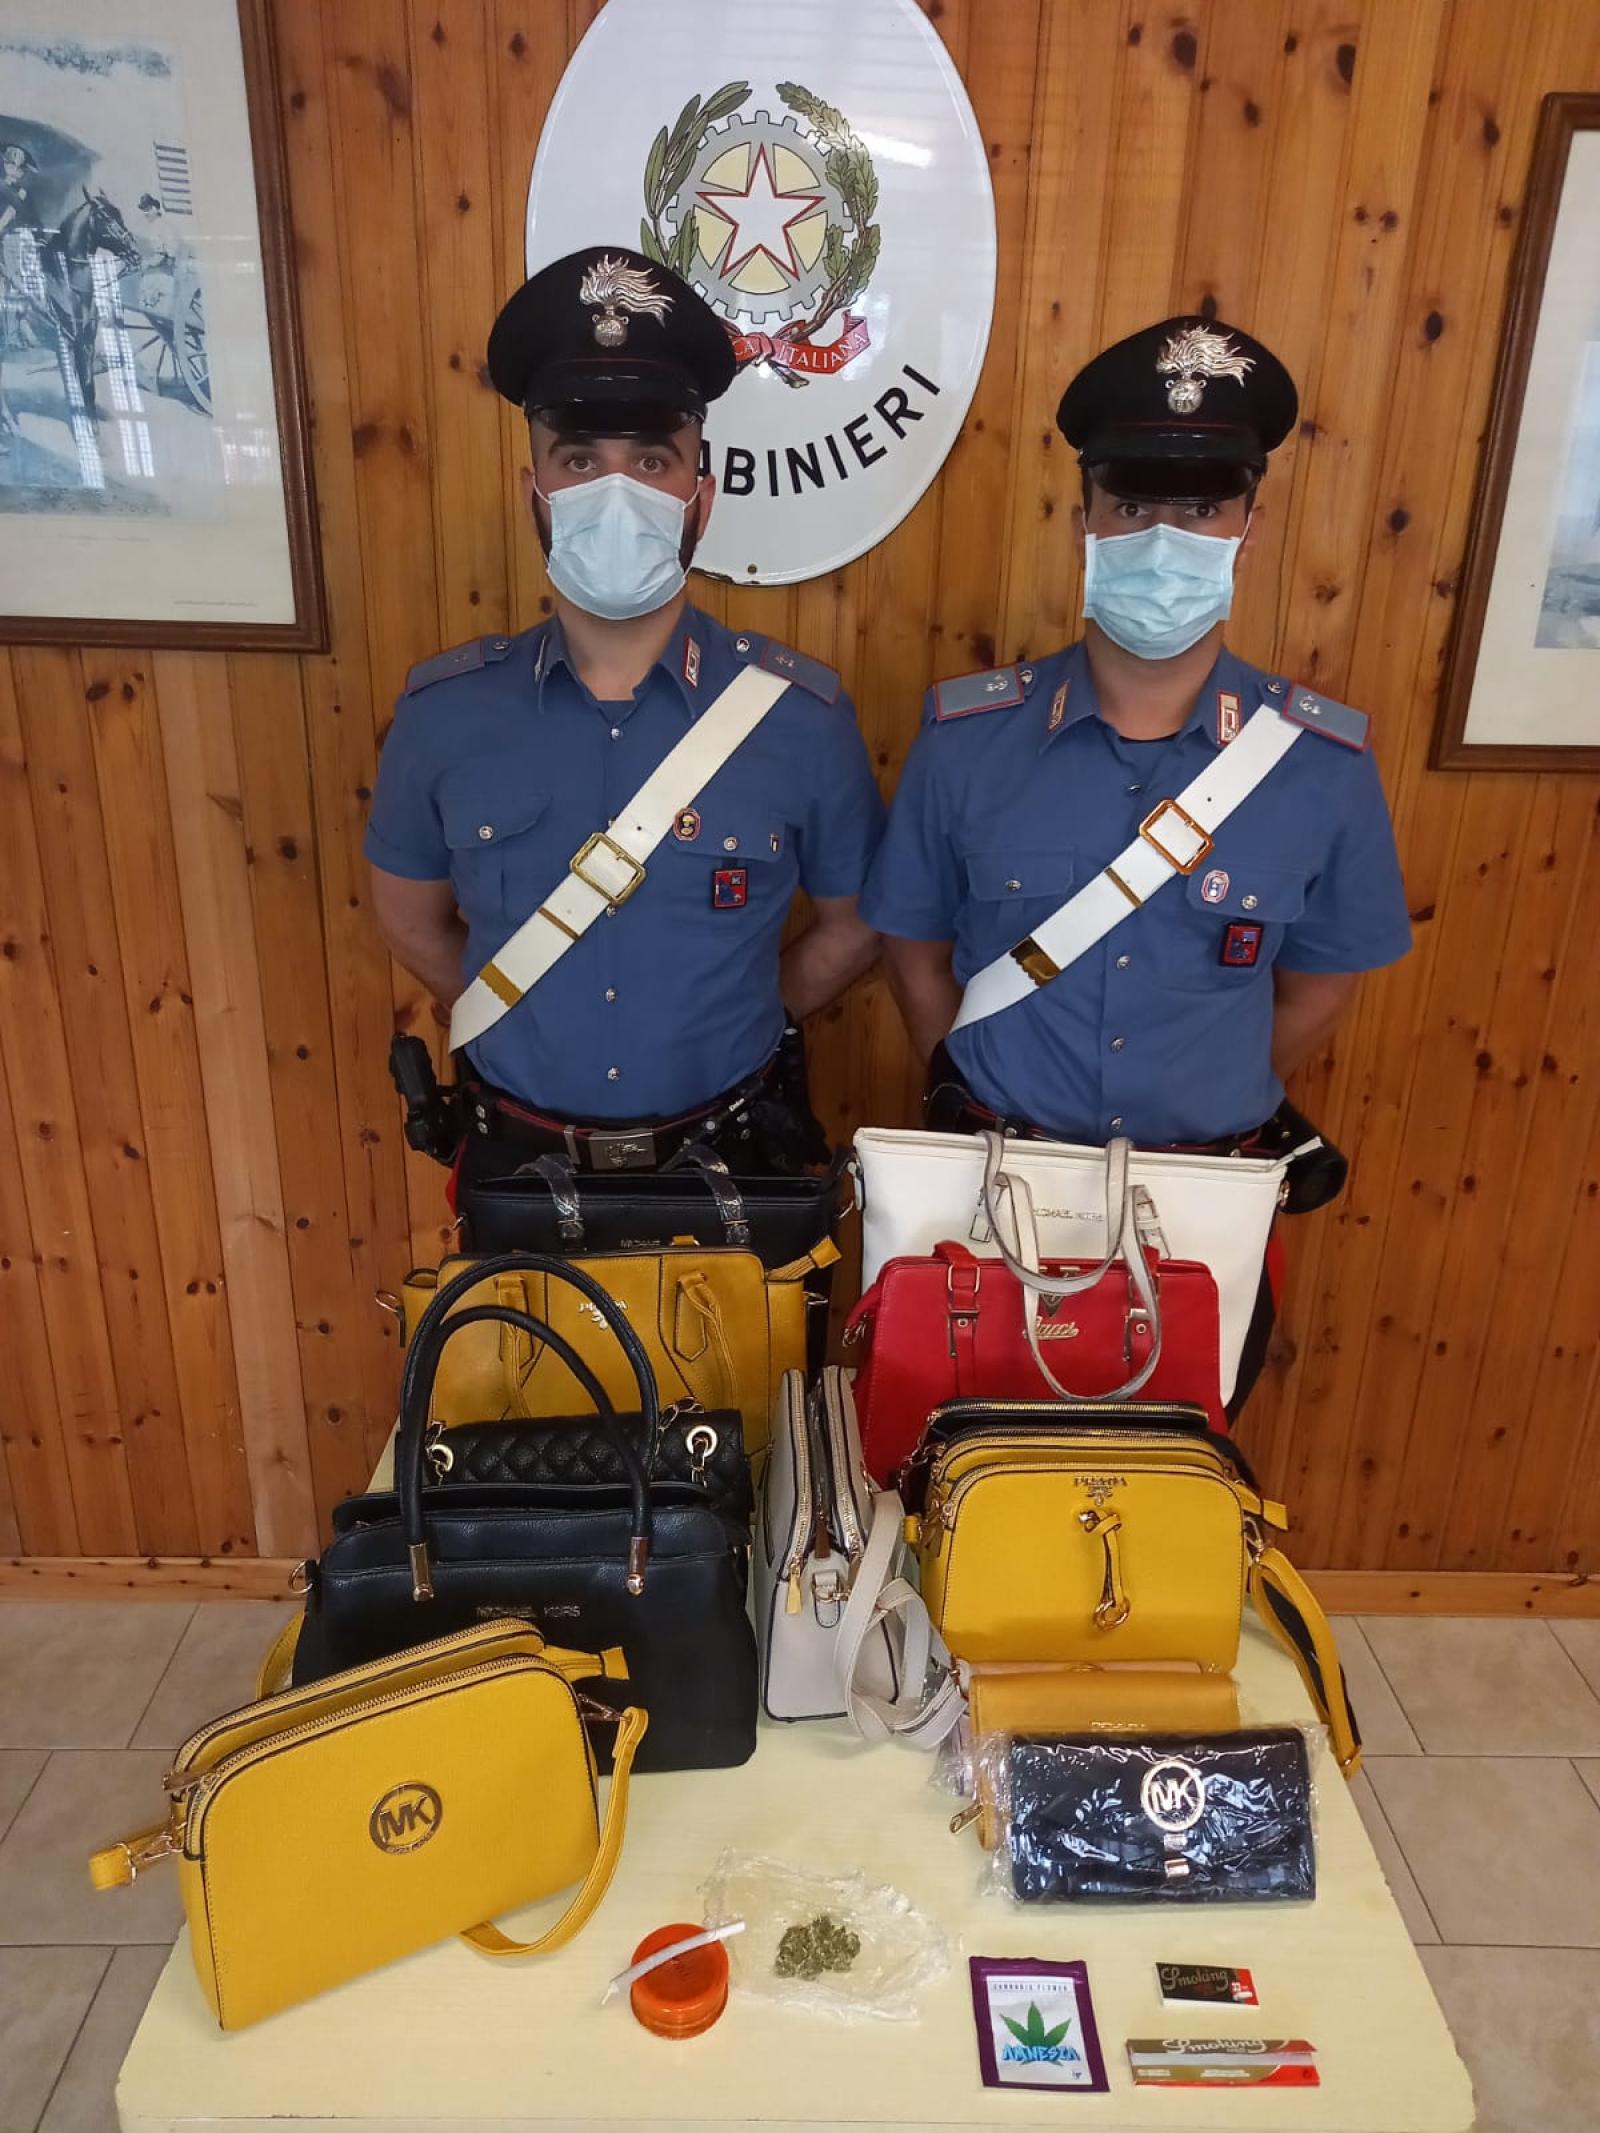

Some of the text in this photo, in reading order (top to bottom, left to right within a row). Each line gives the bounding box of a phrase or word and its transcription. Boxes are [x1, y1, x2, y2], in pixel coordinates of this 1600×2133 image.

[778, 331, 868, 370] ITALIANA
[1151, 1777, 1195, 1812] MK
[380, 1796, 432, 1841] MK
[1160, 1966, 1229, 1992] Smoking
[1162, 2038, 1267, 2054] Smoking
